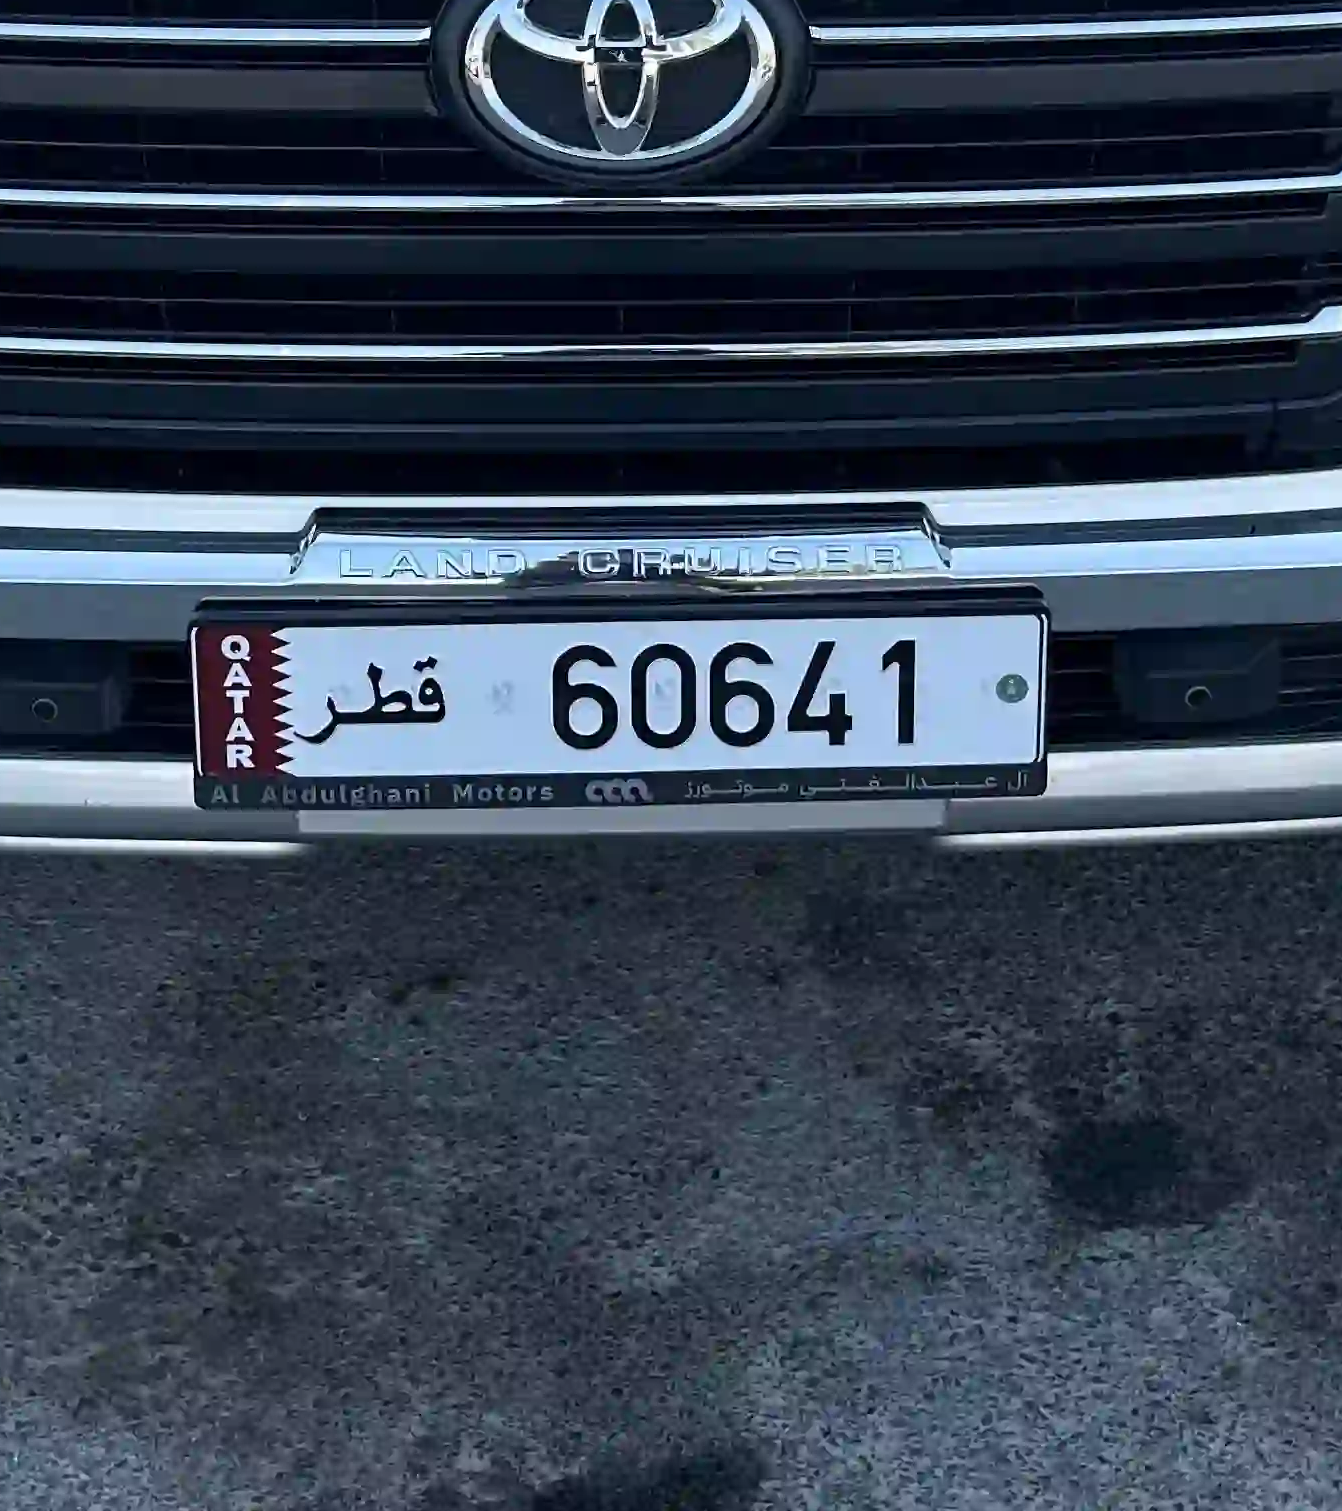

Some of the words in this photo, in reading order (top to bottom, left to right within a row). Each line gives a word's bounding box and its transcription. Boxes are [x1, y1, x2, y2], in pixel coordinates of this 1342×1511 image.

[338, 548, 527, 580] LAND
[577, 544, 904, 579] CRUISER
[220, 633, 256, 770] QATAR
[293, 654, 447, 745] قطر
[551, 638, 918, 751] 60641
[210, 783, 241, 805] Al
[260, 782, 433, 808] Abdulghani
[453, 782, 556, 805] Motors
